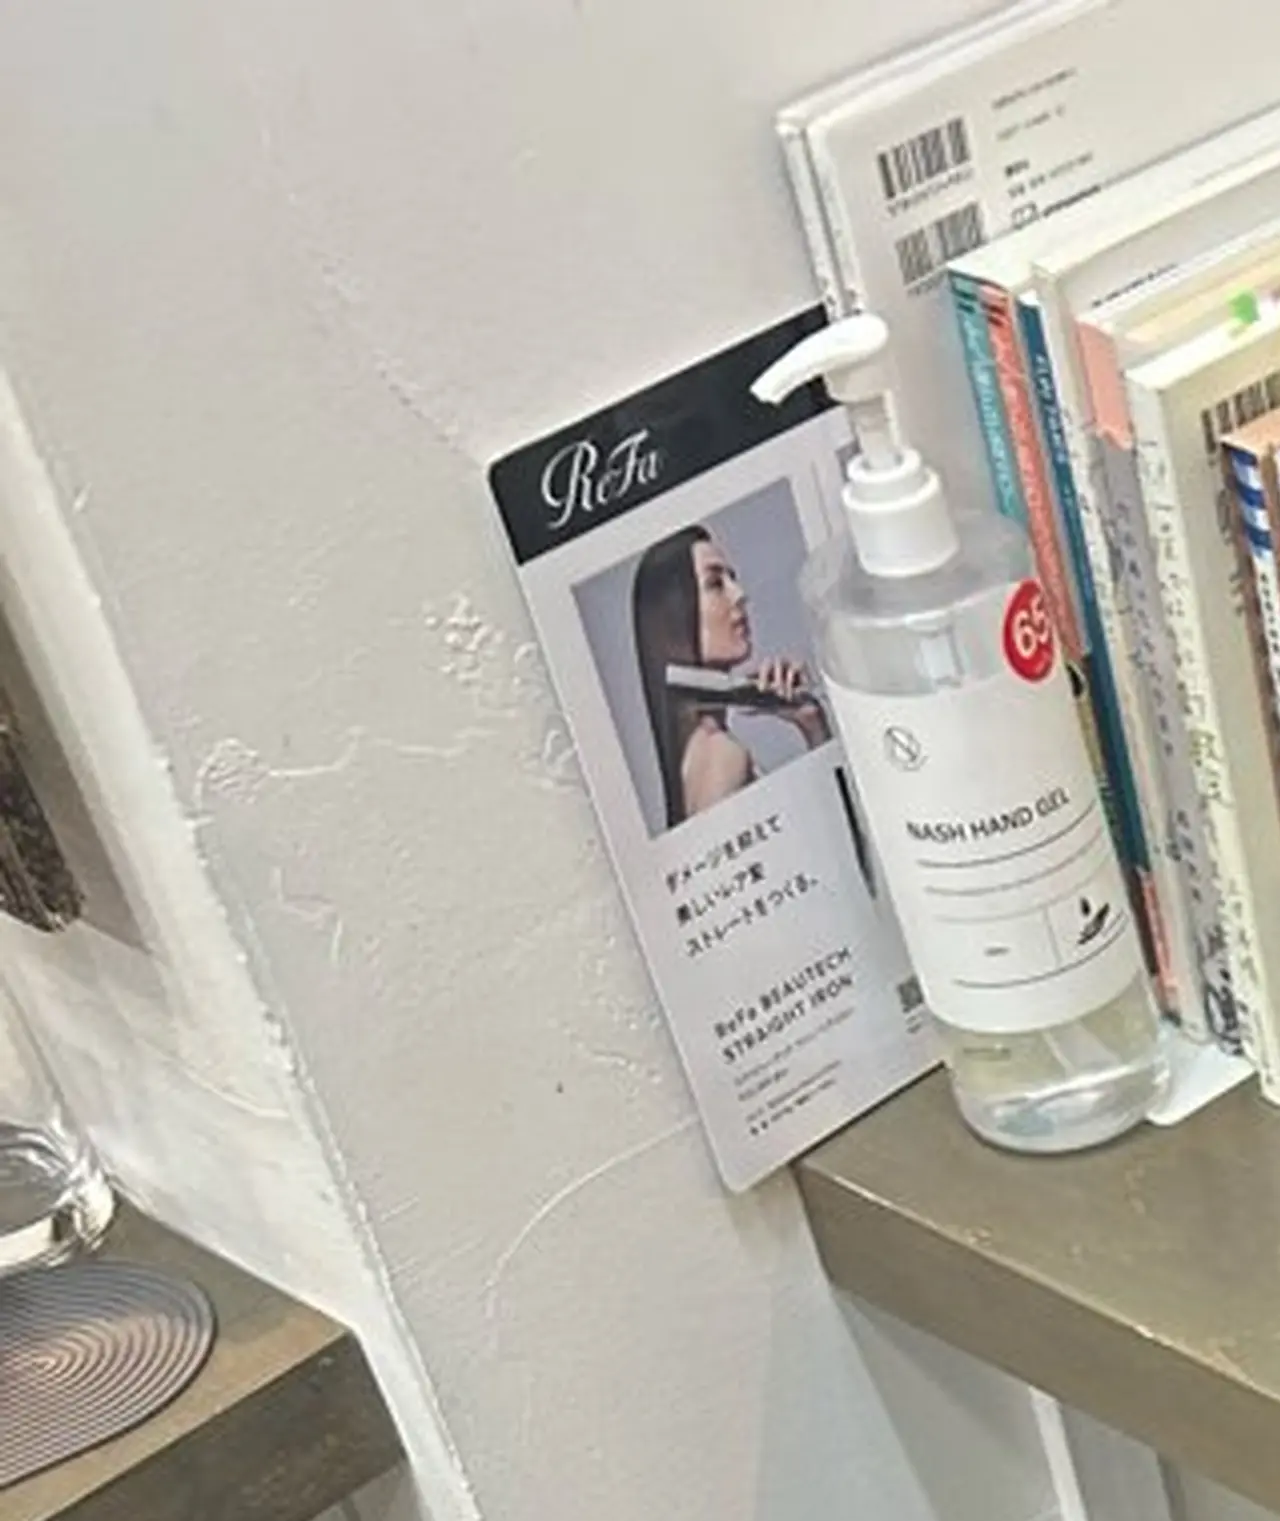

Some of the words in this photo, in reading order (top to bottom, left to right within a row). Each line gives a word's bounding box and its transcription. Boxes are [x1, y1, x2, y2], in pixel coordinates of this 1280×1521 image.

[541, 428, 664, 530] ReFa
[906, 819, 965, 844] NASH
[969, 805, 1034, 841] HAND
[1036, 786, 1072, 818] GEL
[758, 946, 852, 1010] BEAUTECH
[721, 1000, 806, 1065] STRAIGHT
[809, 976, 855, 1008] IRON
